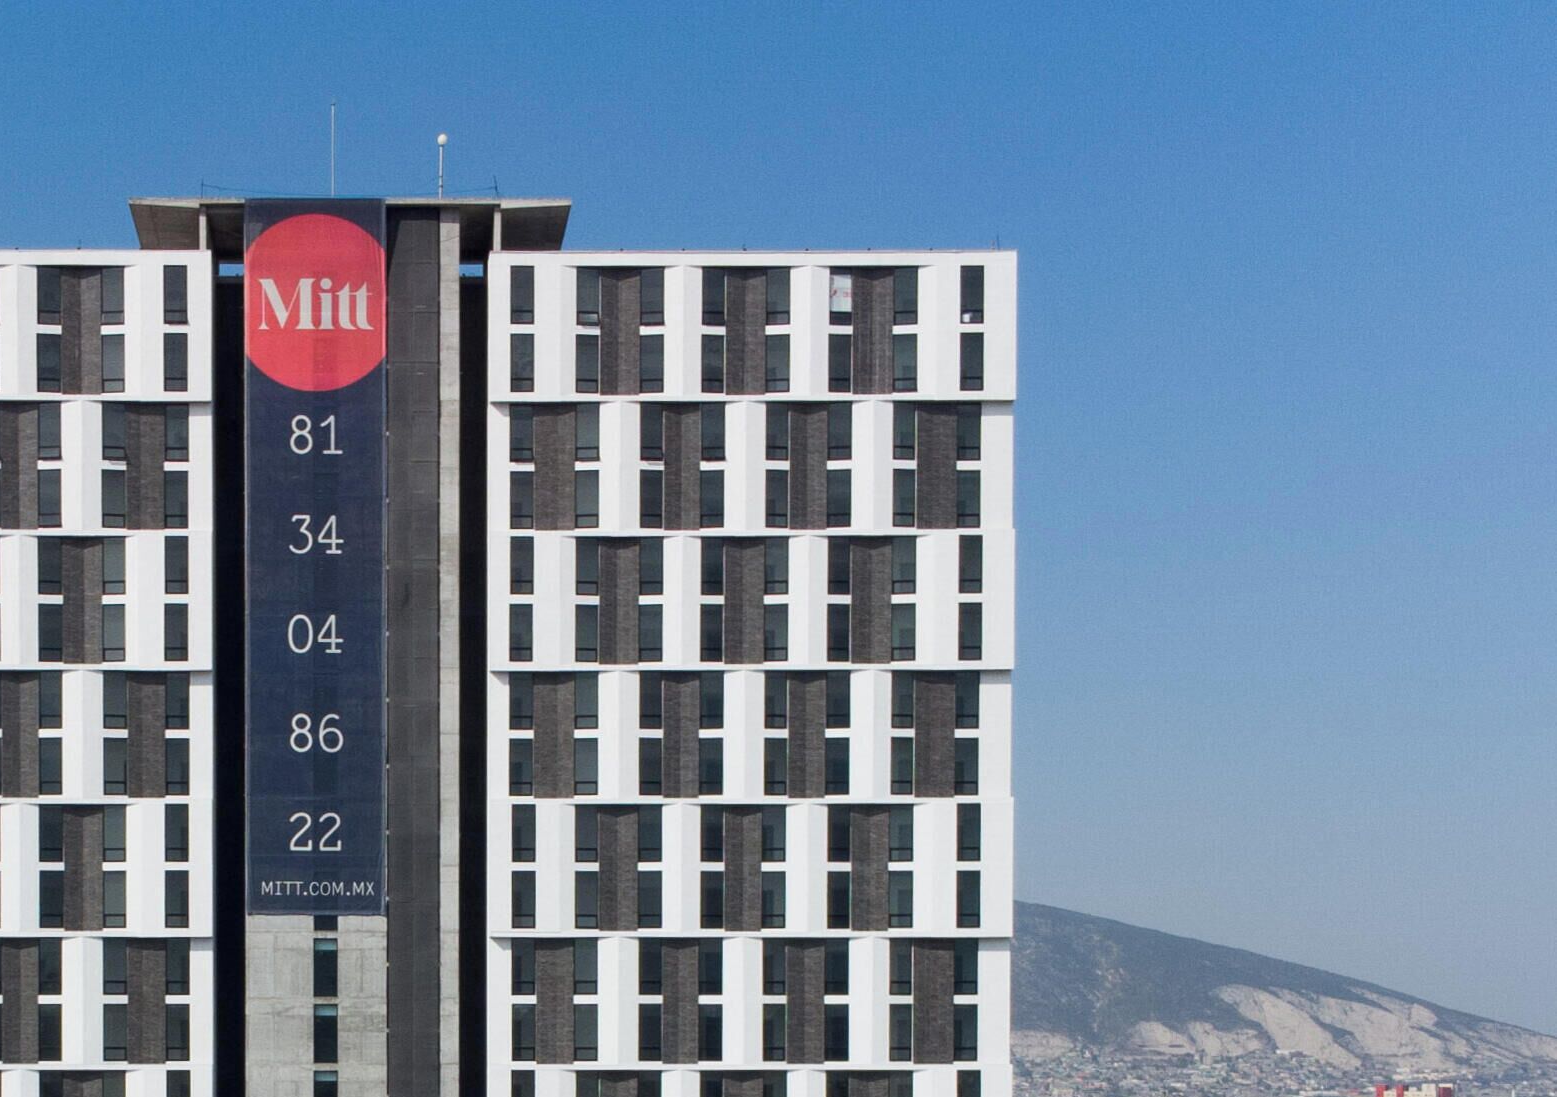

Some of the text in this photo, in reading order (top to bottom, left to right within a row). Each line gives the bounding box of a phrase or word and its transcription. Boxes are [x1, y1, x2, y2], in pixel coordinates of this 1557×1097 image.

[258, 277, 375, 330] Mitt
[289, 414, 344, 455] 81
[288, 514, 345, 555] 34
[287, 614, 344, 654] 04
[289, 713, 344, 753] 86
[289, 812, 342, 851] 22
[261, 881, 375, 896] MITT.COM.MX
